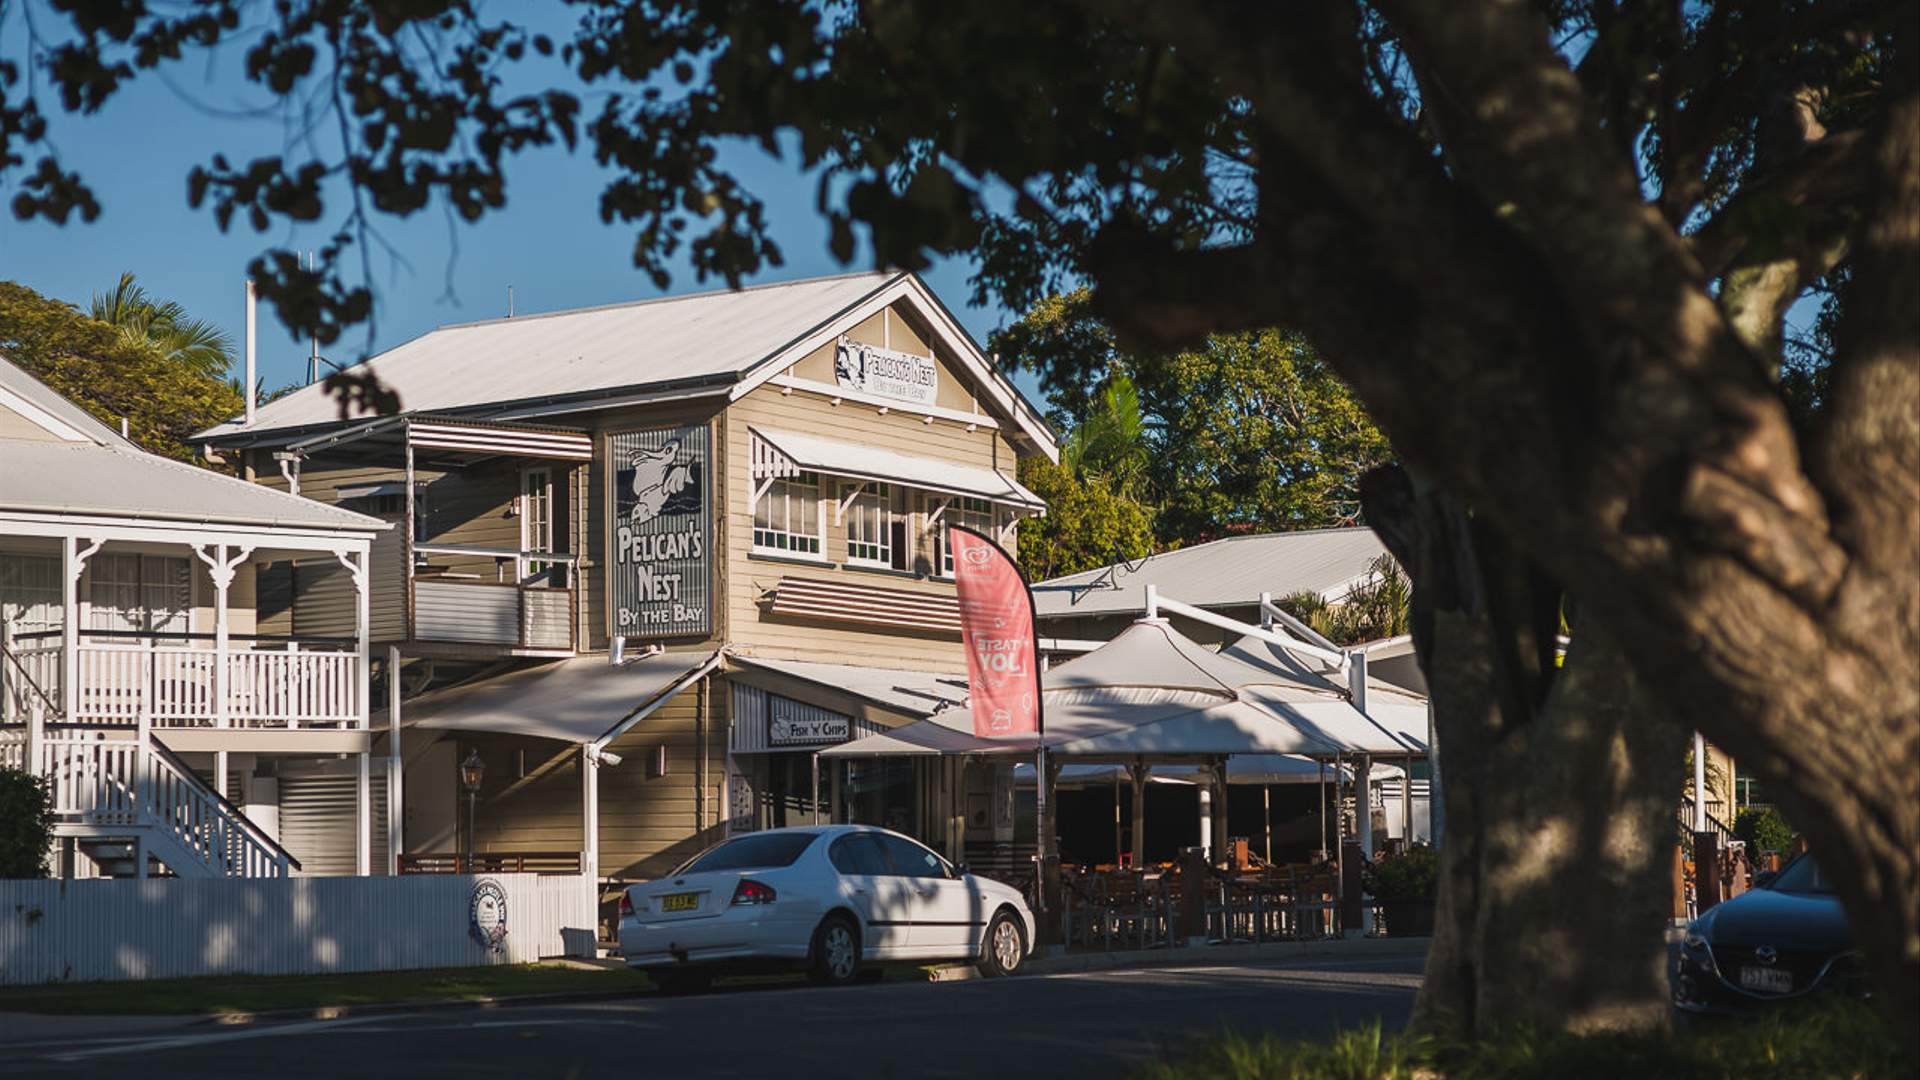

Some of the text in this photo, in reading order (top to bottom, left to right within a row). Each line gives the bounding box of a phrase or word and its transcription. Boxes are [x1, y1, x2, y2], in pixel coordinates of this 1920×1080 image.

[864, 346, 935, 387] PELICAN'S NEST
[617, 520, 702, 564] PELICAN'S
[637, 564, 682, 601] NEST
[618, 603, 702, 626] BY THE BAY
[790, 724, 809, 737] FISH
[823, 722, 846, 736] CHIPS
